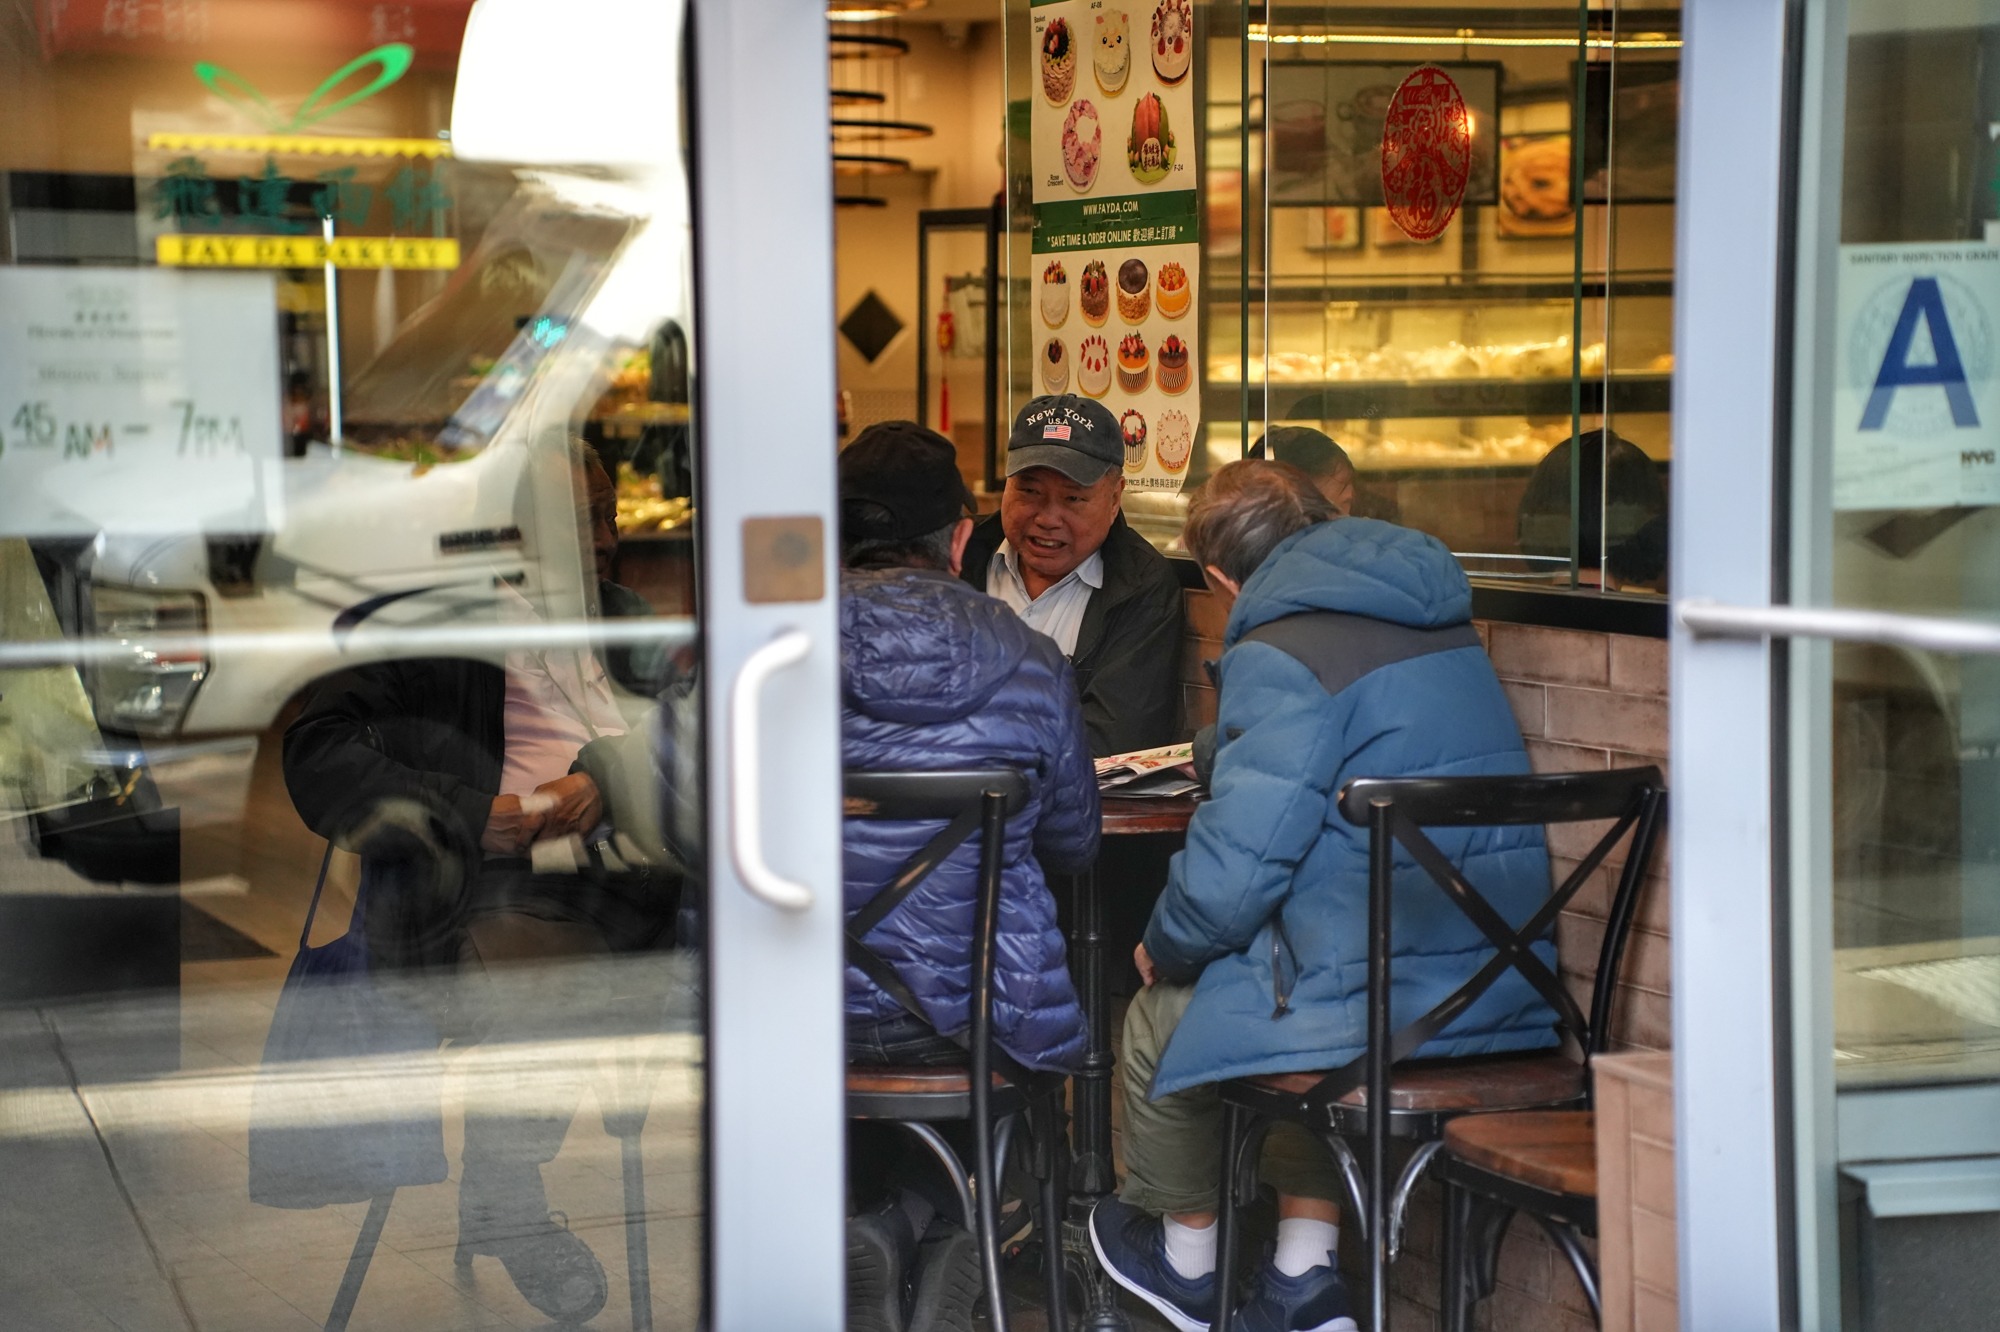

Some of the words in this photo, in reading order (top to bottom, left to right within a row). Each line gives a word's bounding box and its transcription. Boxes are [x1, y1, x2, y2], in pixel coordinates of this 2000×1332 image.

[1083, 201, 1139, 216] WWW.FAYDA.COM
[1051, 235, 1066, 248] SAVE
[1066, 234, 1081, 246] TIME
[1082, 234, 1087, 245] &
[1088, 232, 1106, 244] ORDER
[1107, 229, 1132, 243] ONLINE
[1858, 275, 1982, 432] A
[1026, 408, 1057, 426] New
[1064, 408, 1095, 431] York
[1961, 450, 1995, 466] NYC
